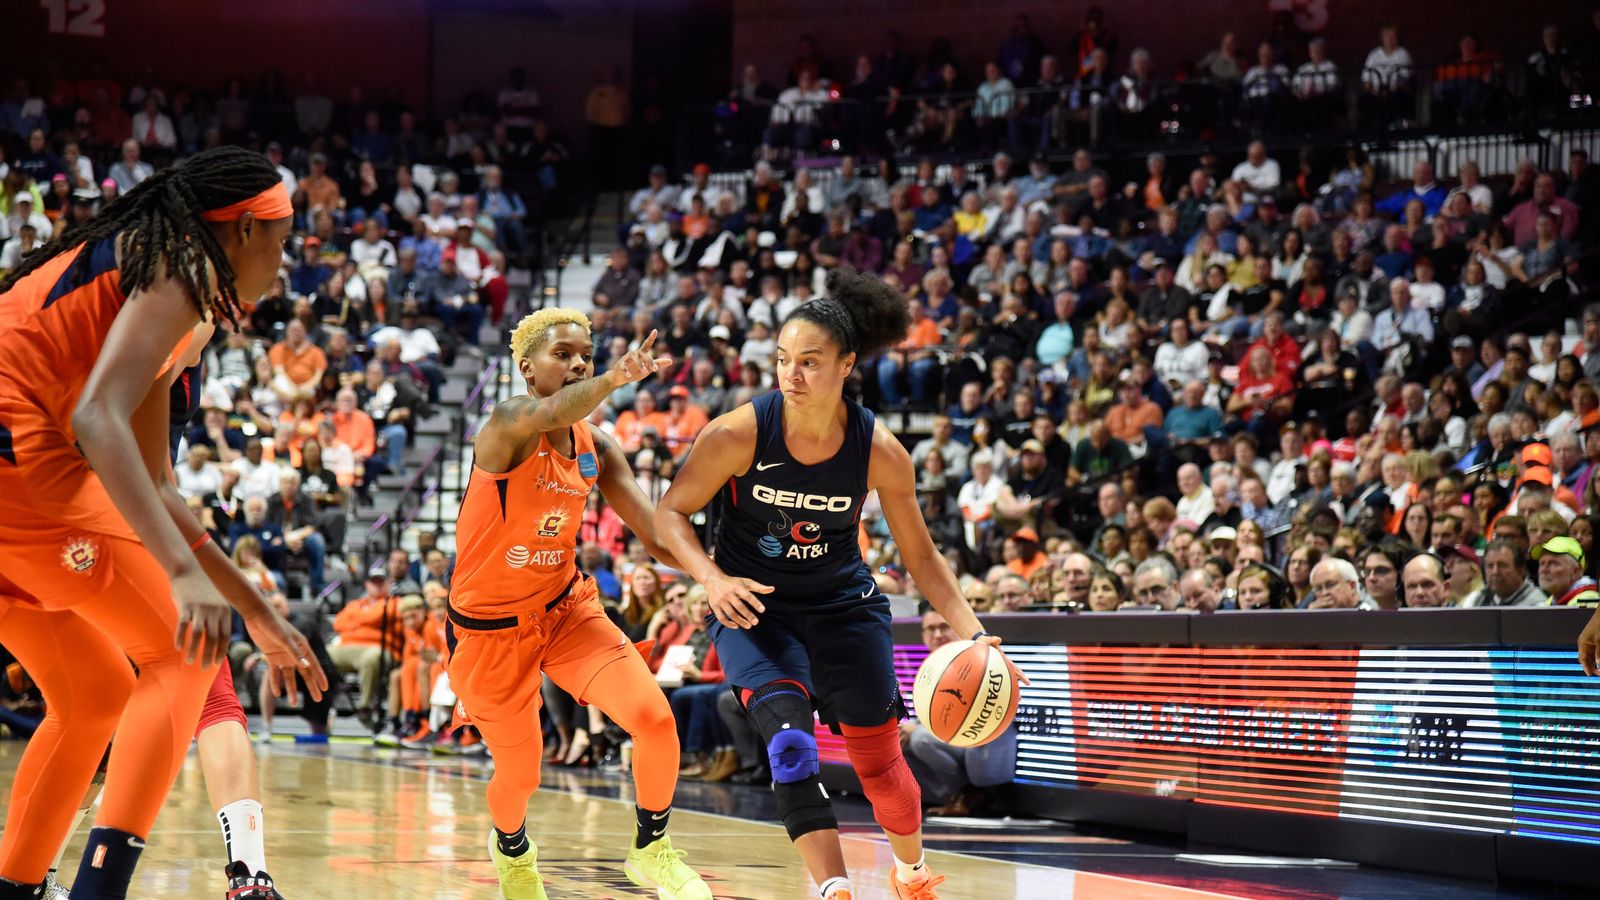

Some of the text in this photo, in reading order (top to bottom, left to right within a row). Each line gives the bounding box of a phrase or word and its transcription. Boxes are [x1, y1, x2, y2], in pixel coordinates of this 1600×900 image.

[40, 0, 106, 37] 12
[752, 485, 852, 512] GEICO
[529, 550, 565, 566] AT&T
[962, 670, 1004, 740] SPALDING
